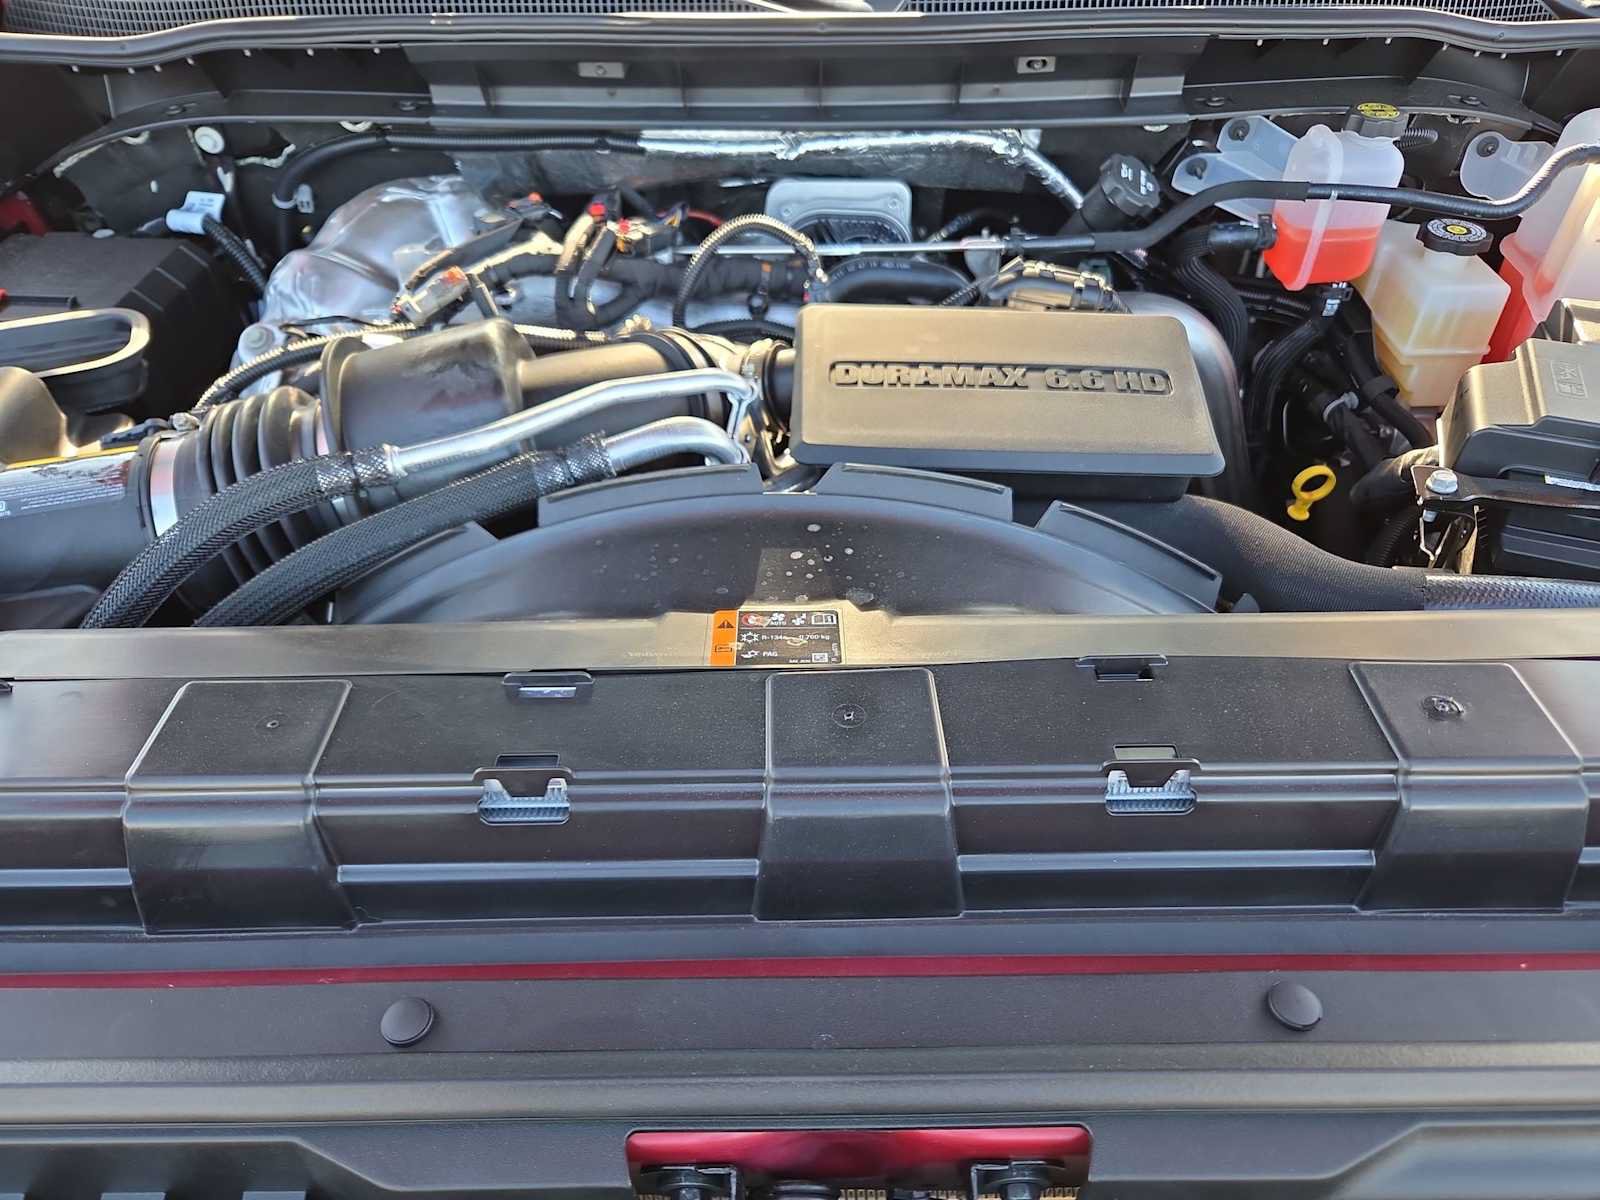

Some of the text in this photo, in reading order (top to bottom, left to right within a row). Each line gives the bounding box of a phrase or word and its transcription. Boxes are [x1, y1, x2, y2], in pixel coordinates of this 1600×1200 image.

[833, 362, 1168, 393] DURAMAX 6.6 HD
